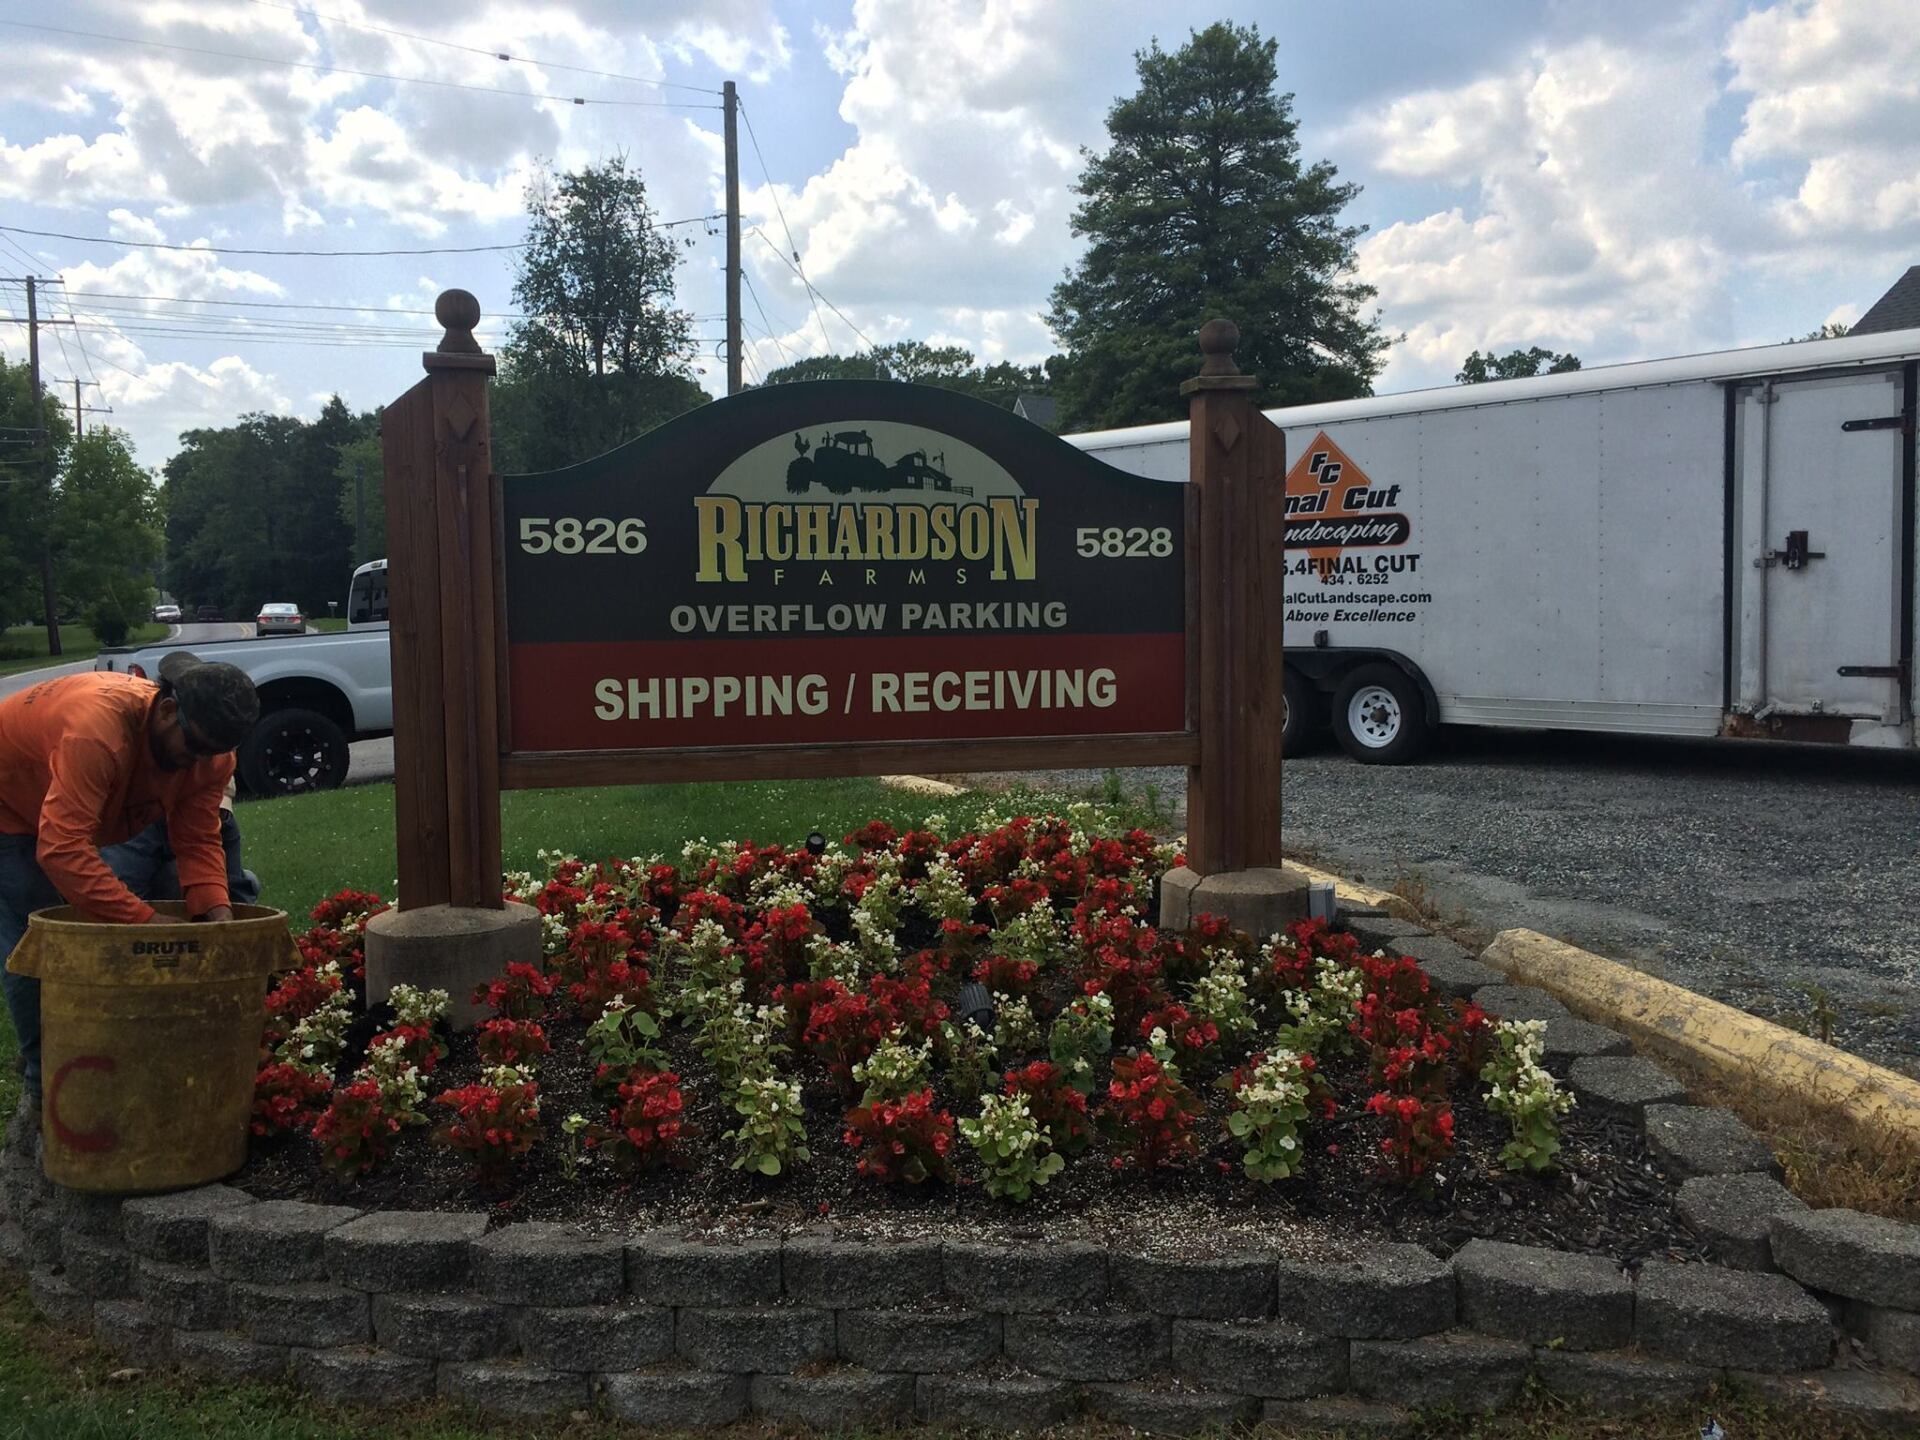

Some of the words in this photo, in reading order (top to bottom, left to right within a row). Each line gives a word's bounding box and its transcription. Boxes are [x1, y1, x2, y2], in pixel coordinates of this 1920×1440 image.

[1343, 484, 1401, 510] Cut
[519, 517, 648, 554] 5826
[694, 496, 1039, 582] RICHARDSON
[1076, 527, 1174, 557] 5828
[1375, 554, 1420, 573] CUT
[773, 567, 967, 586] FARMS
[1321, 575, 1345, 586] 434
[1357, 573, 1389, 585] 6252
[1283, 592, 1432, 606] alCutLandscape.com
[670, 603, 887, 633] OVERFLOW
[901, 601, 1068, 630] PARKING
[1285, 609, 1330, 622] Above
[1333, 609, 1416, 622] Excellence
[594, 673, 829, 721] SHIPPING
[843, 673, 856, 714] /
[872, 668, 1117, 713] RECEIVING
[133, 940, 200, 954] BRUTE
